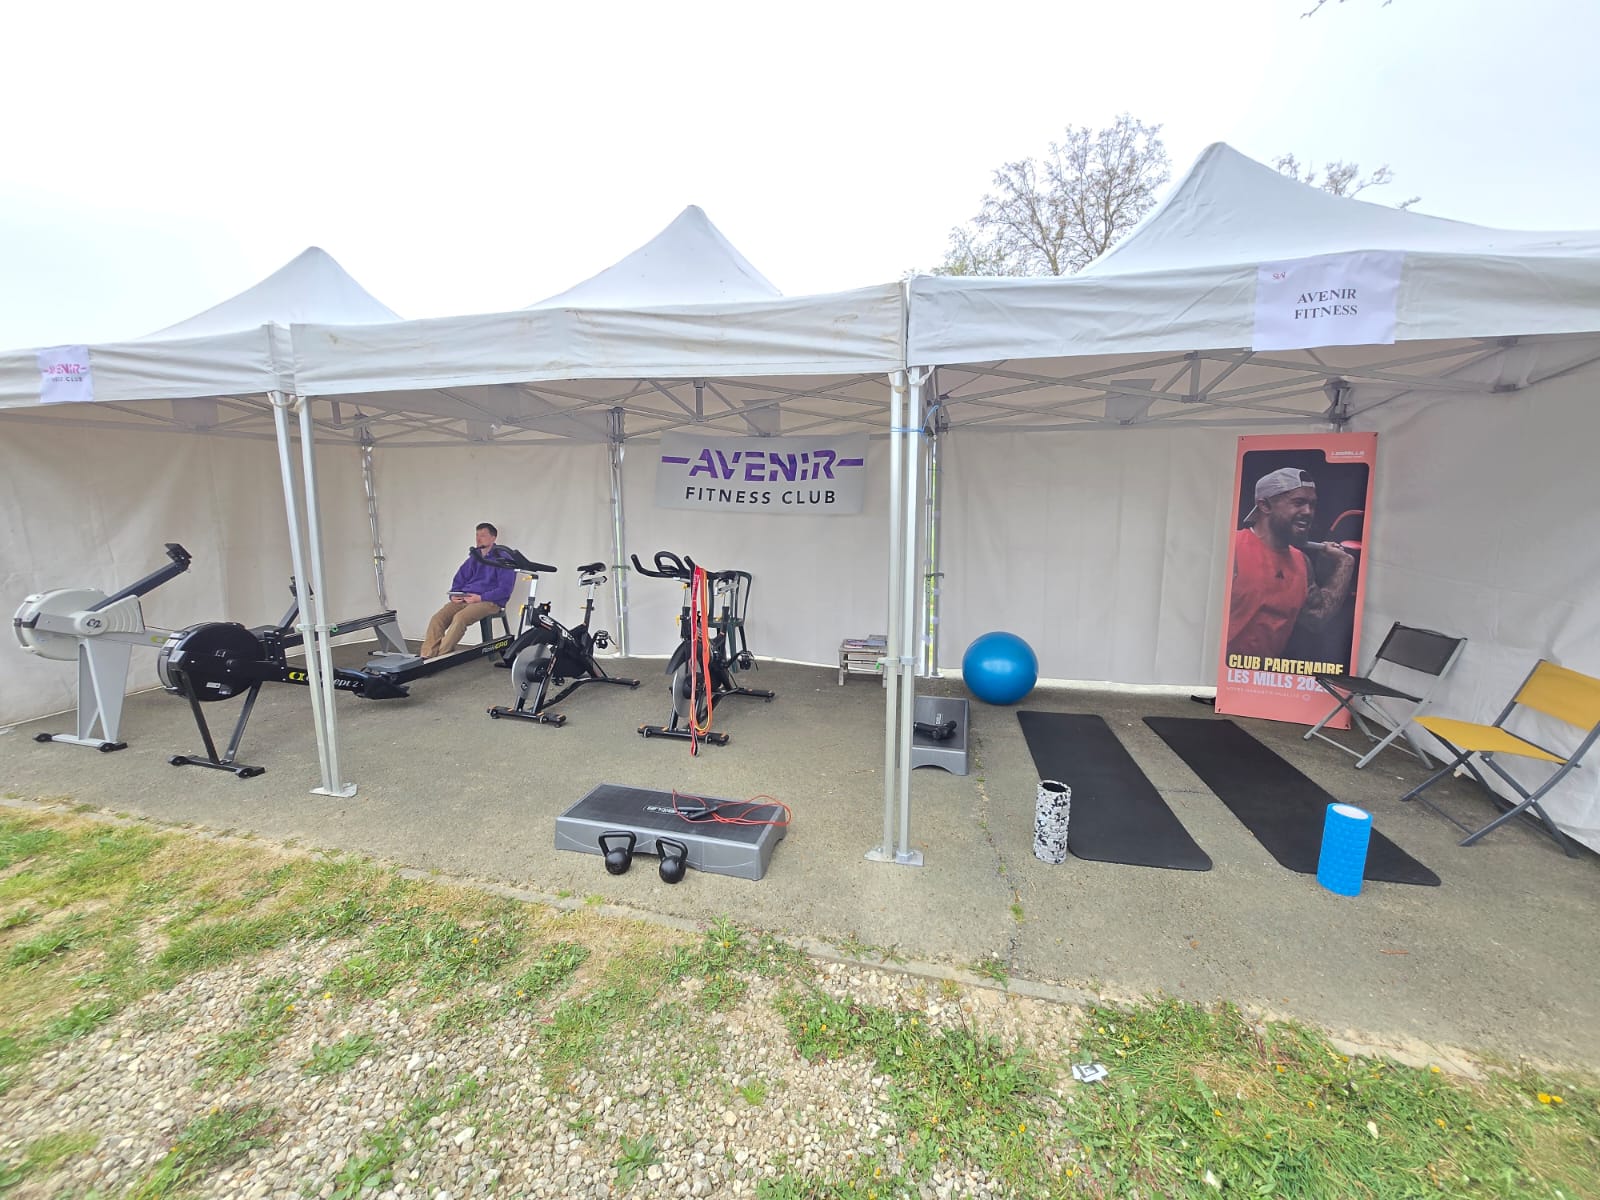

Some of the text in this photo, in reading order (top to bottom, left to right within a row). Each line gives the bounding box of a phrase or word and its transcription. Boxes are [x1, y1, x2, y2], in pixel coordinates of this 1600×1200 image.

[1297, 288, 1357, 304] AVENIR
[1294, 304, 1358, 319] FITNESS
[689, 448, 836, 482] AVENIR
[685, 486, 835, 504] FITNESS CLUB
[1228, 654, 1344, 676] CLUB PARTENAIRE
[1227, 668, 1249, 684] LES
[1253, 670, 1293, 689] MILLS
[1296, 676, 1328, 693] 202
